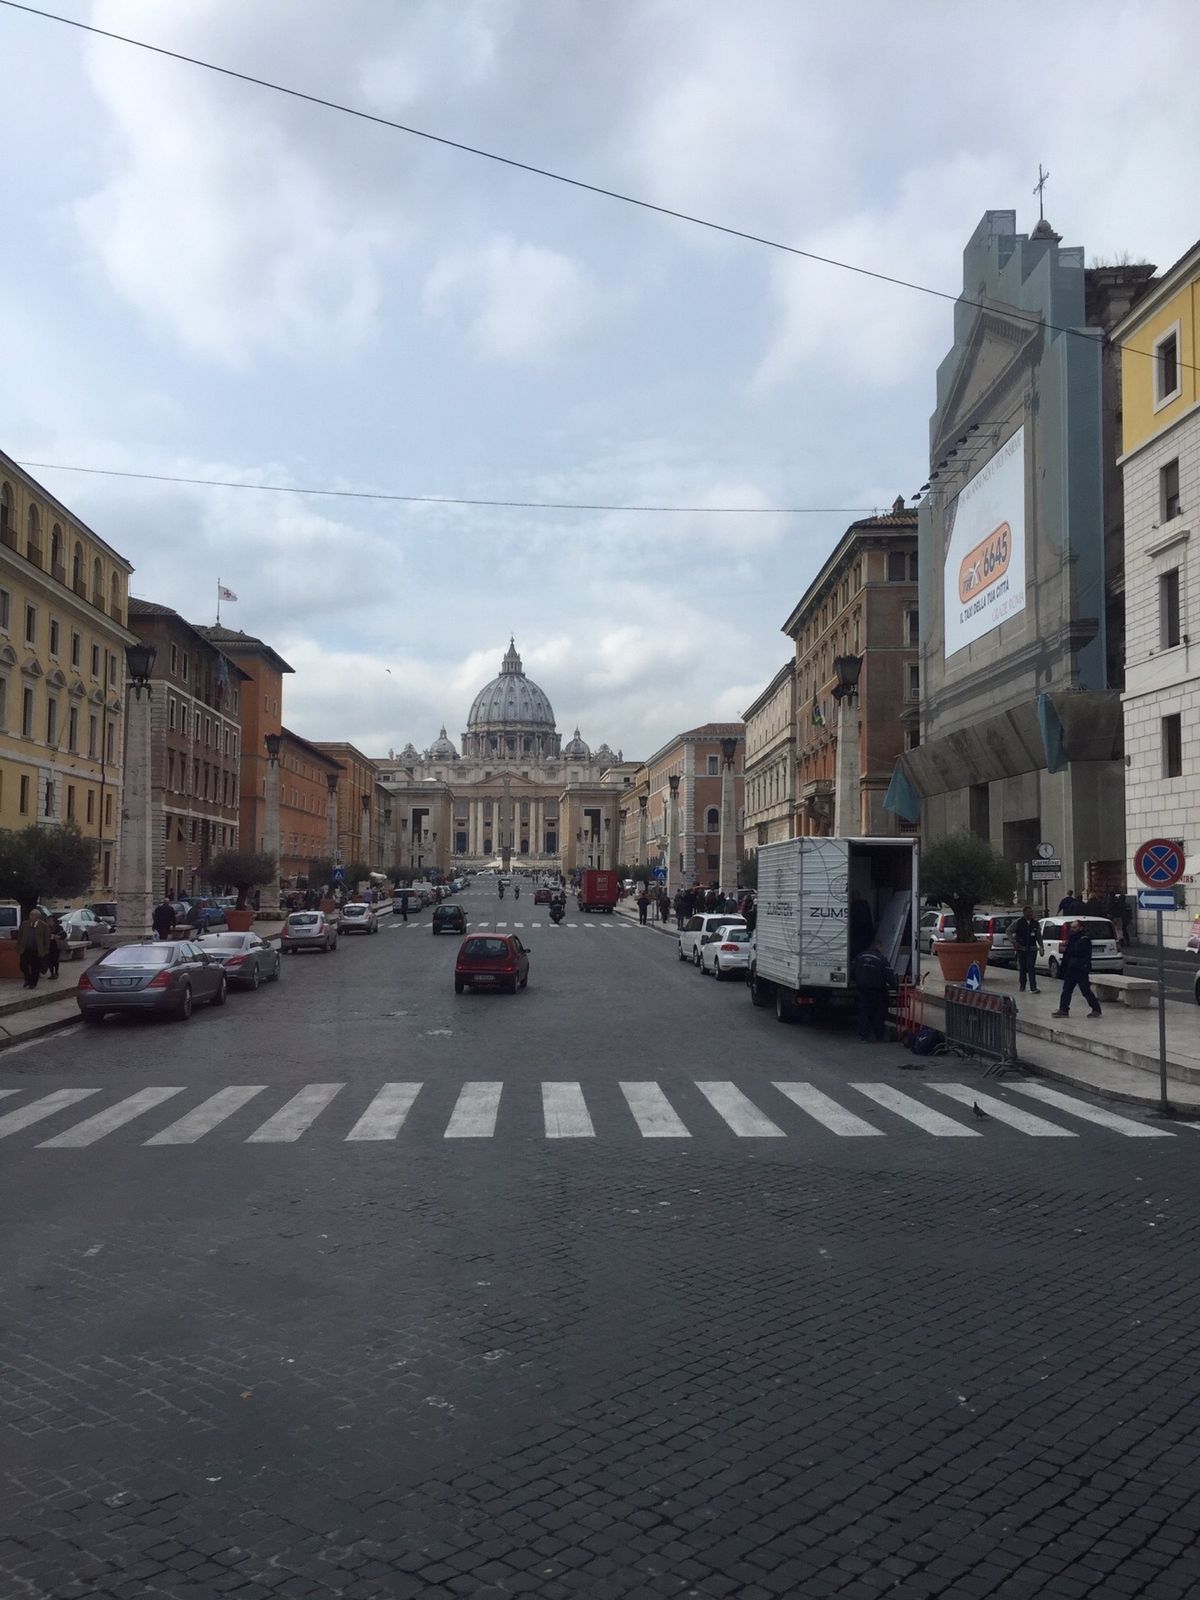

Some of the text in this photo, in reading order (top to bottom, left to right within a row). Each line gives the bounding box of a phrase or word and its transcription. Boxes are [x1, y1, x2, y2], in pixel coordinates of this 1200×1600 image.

[983, 531, 1008, 577] 6645
[964, 604, 973, 621] TAXI
[973, 597, 986, 615] DELLA
[986, 588, 996, 607] TUA
